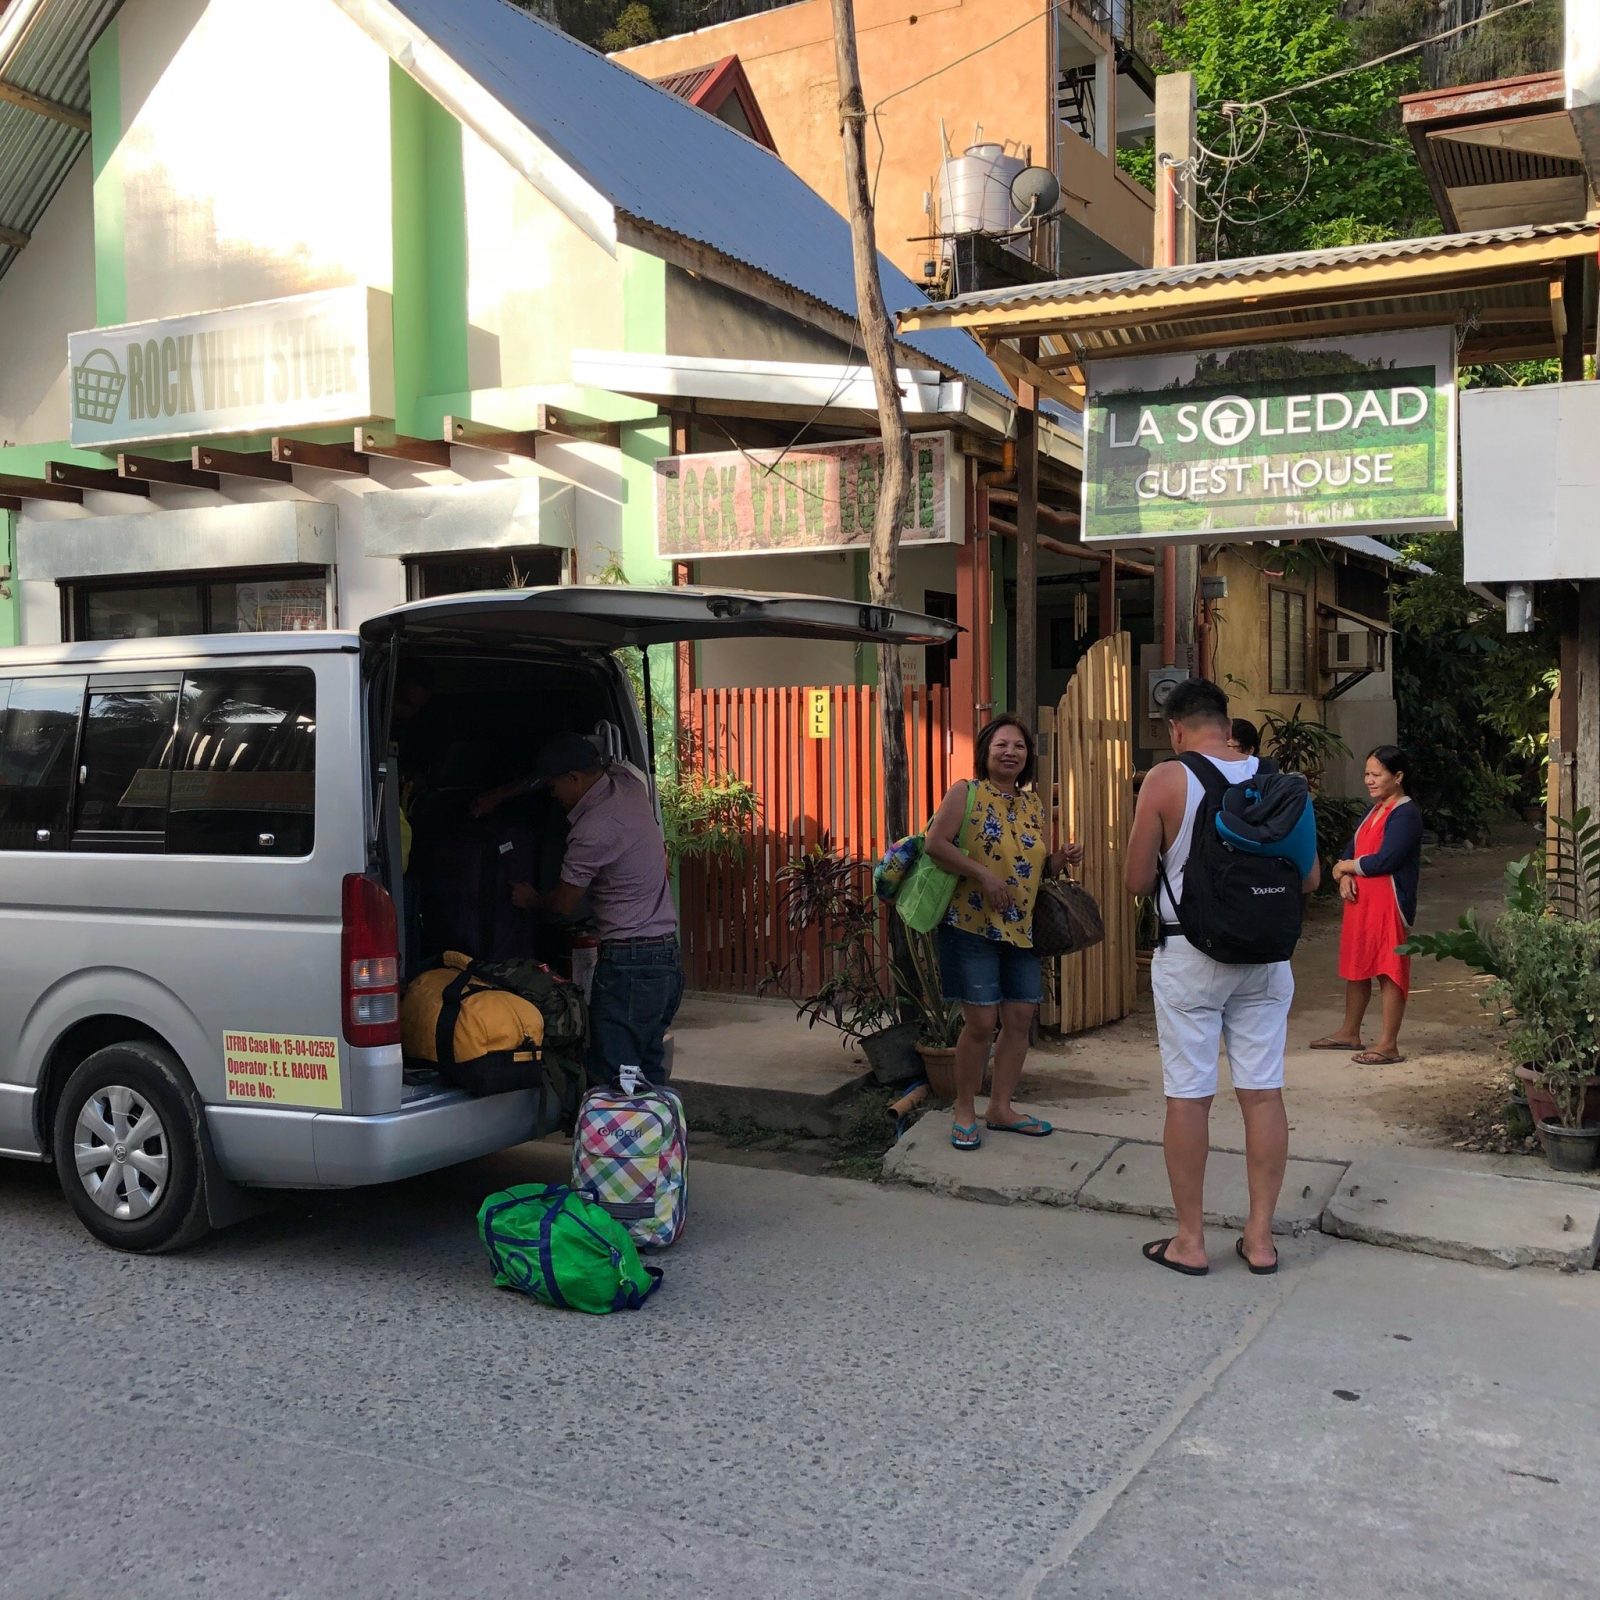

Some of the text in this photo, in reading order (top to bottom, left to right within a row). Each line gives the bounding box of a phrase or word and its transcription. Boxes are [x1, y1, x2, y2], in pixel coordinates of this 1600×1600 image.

[127, 314, 357, 420] ROCK VIEW STORE
[1109, 386, 1428, 448] LA SOLEDAD
[839, 449, 934, 533] LOE
[1135, 454, 1393, 498] GUEST HOUSE
[815, 694, 824, 734] PULL
[226, 1035, 336, 1058] LTFRB Case No: 15-04-02552
[227, 1057, 268, 1076] Operator
[273, 1061, 281, 1077] E.
[282, 1061, 290, 1078] E.
[291, 1062, 328, 1080] RACUYA
[229, 1080, 276, 1099] Plate No:
